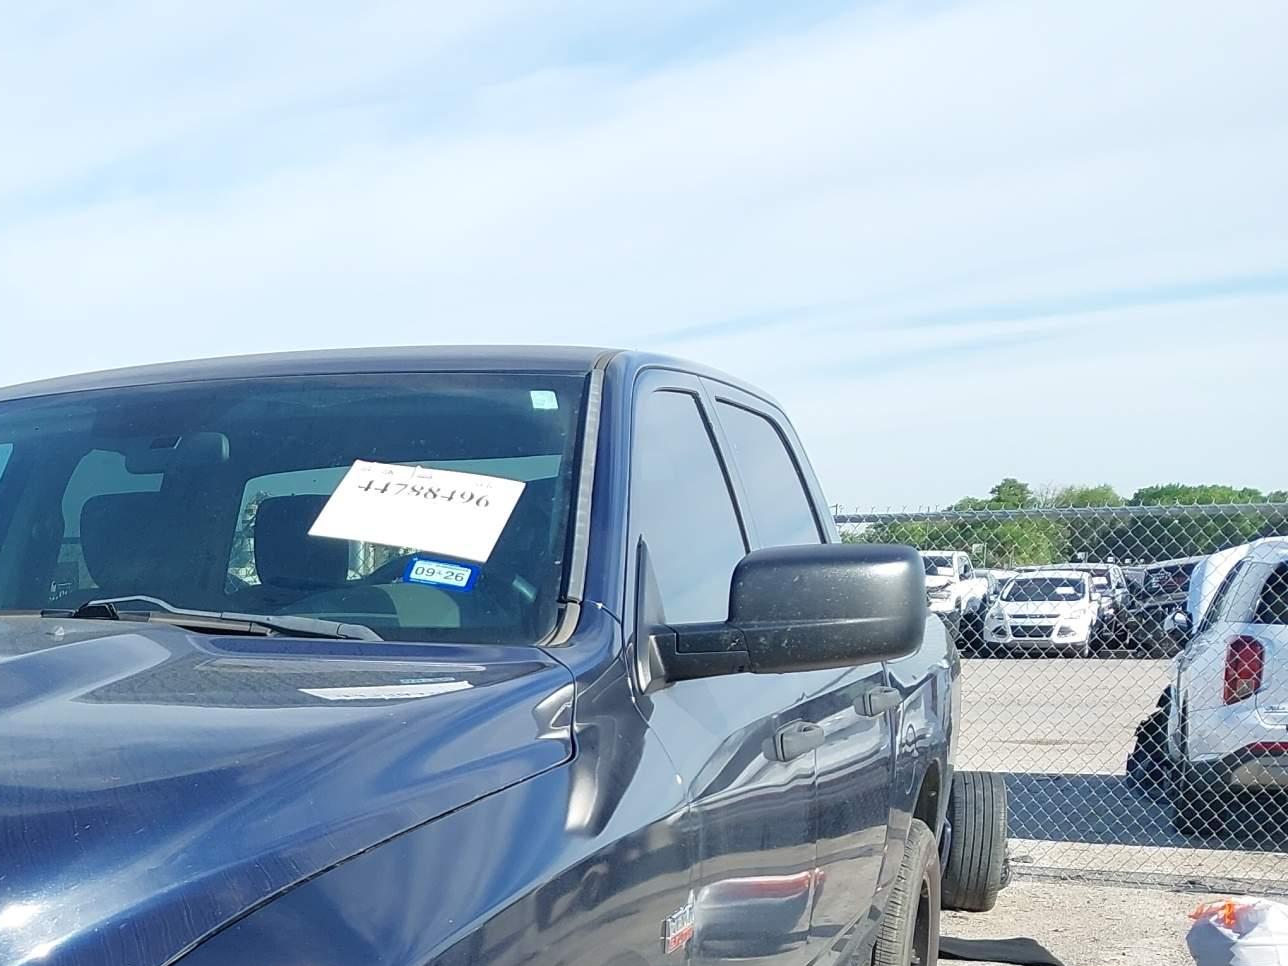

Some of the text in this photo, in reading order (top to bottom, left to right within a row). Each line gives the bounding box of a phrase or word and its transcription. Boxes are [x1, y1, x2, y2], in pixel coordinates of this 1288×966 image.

[357, 479, 490, 508] 44788496
[415, 566, 465, 582] 09 26
